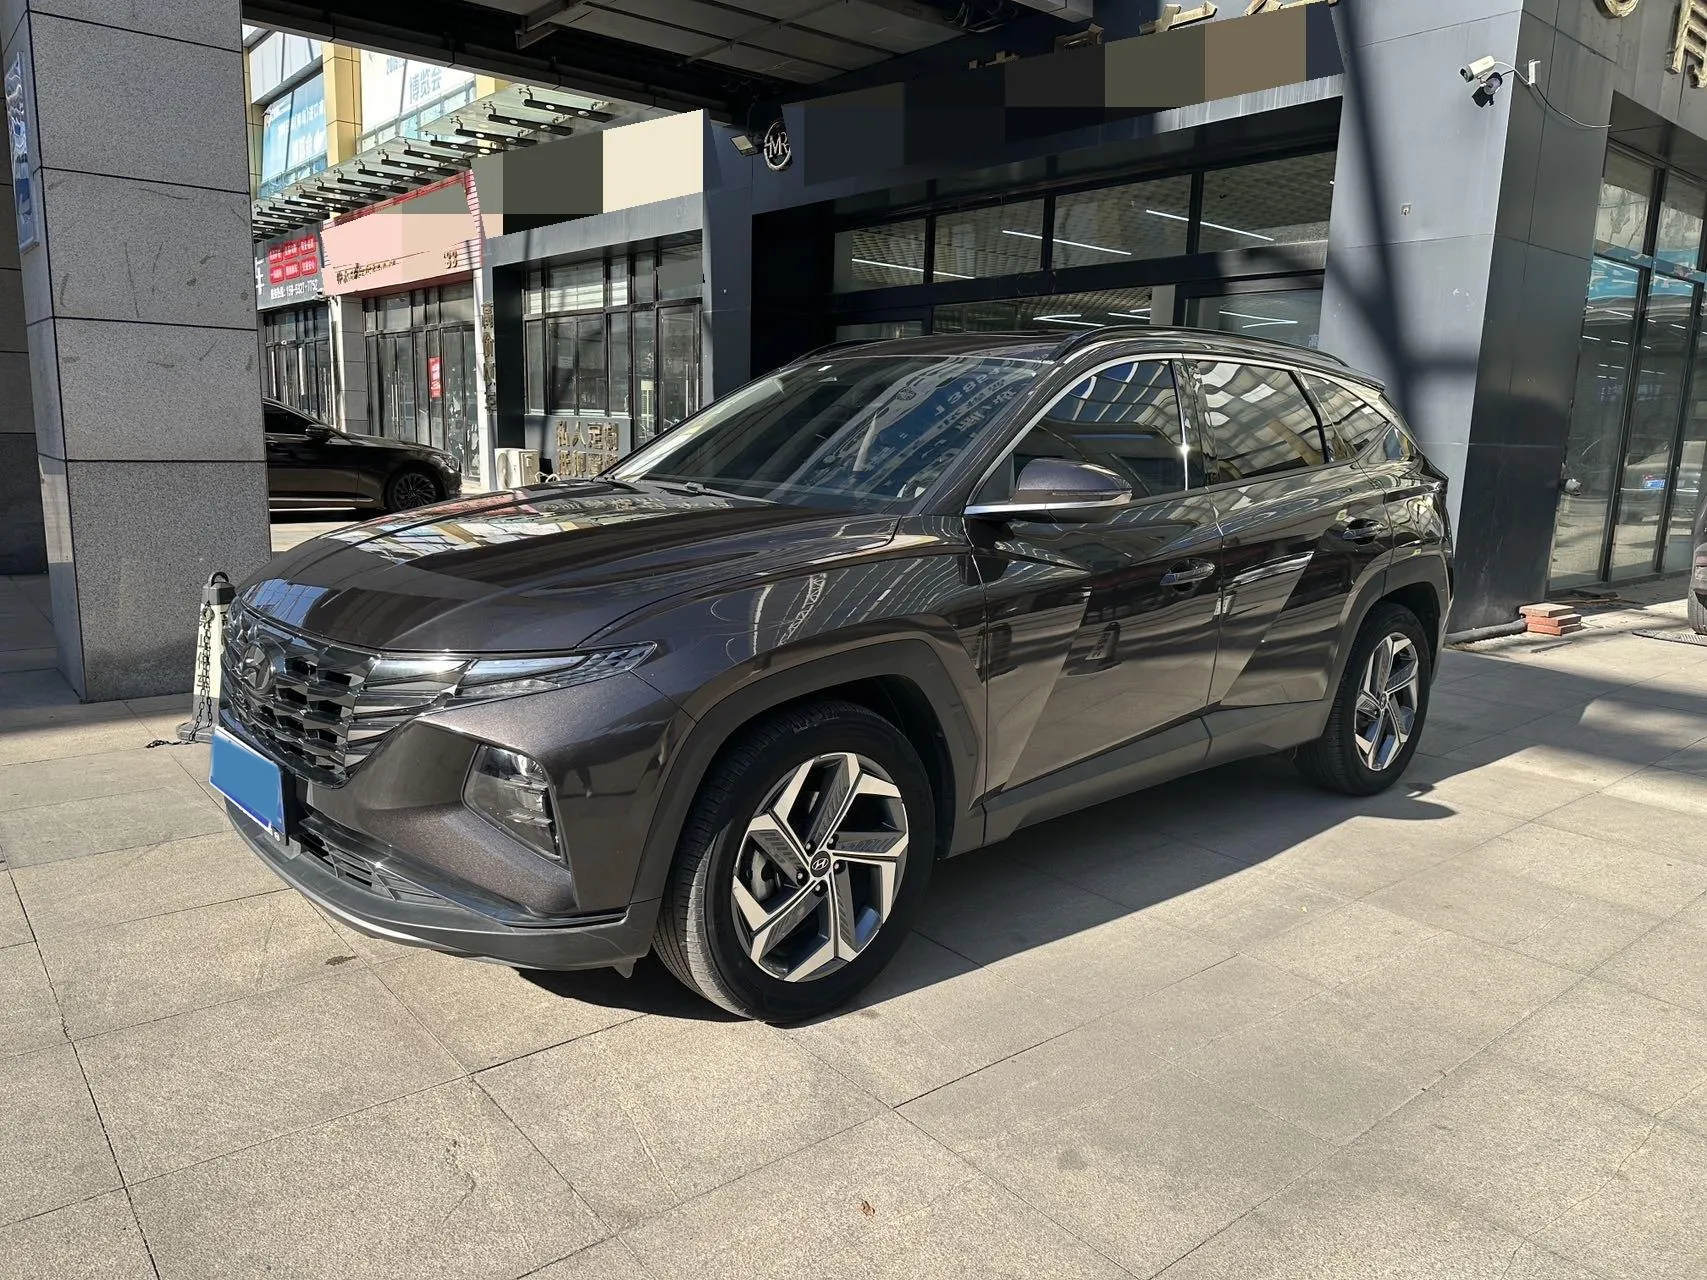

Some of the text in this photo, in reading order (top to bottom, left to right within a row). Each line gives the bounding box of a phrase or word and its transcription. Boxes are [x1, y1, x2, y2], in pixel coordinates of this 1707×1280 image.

[409, 67, 442, 104] 博览会
[556, 421, 619, 451] 私人定制
